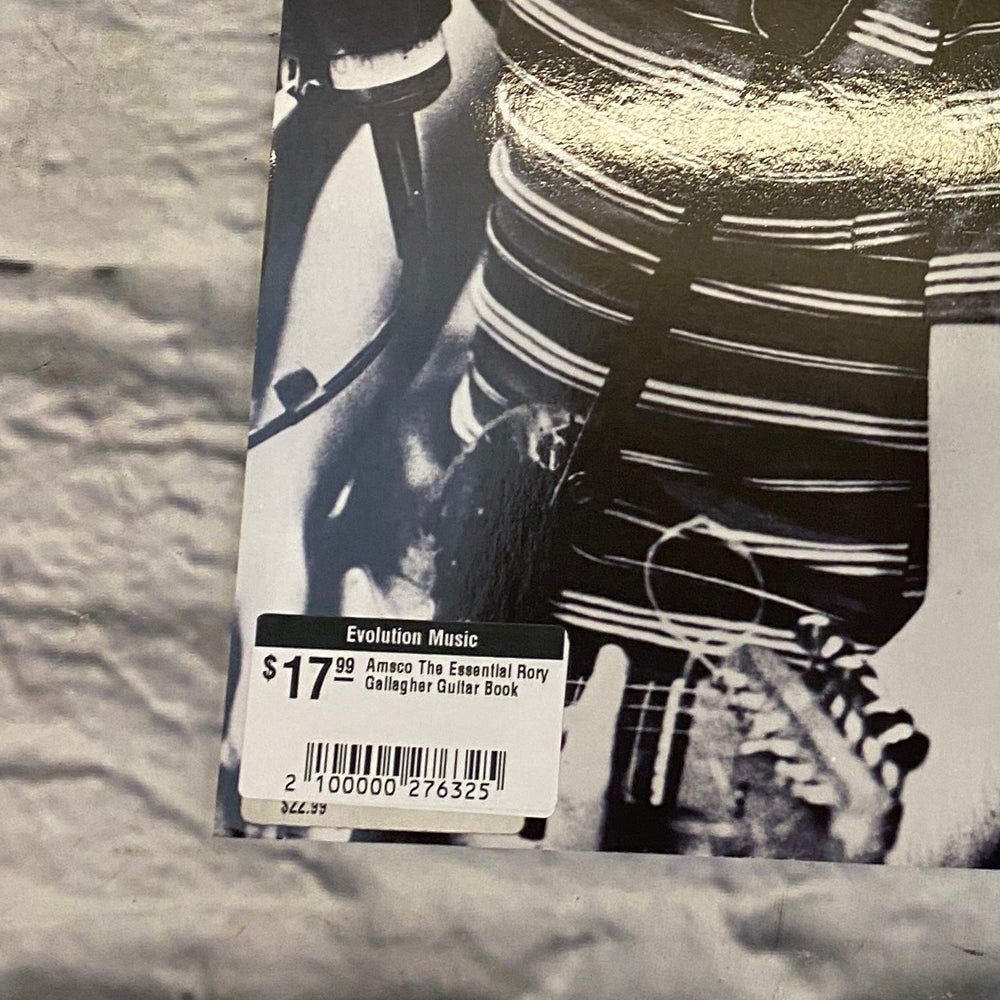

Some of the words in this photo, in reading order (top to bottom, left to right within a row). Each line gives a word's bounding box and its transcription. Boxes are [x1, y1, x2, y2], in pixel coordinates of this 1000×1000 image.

[346, 626, 422, 645] Evolution
[429, 629, 478, 648] Music
[366, 658, 412, 674] Amsco
[419, 659, 443, 675] The
[517, 665, 549, 683] Rory
[365, 676, 433, 695] Gallagher
[485, 681, 518, 697] Book
[284, 774, 296, 791] 2
[316, 775, 396, 796] 100000
[409, 780, 489, 800] 276325
